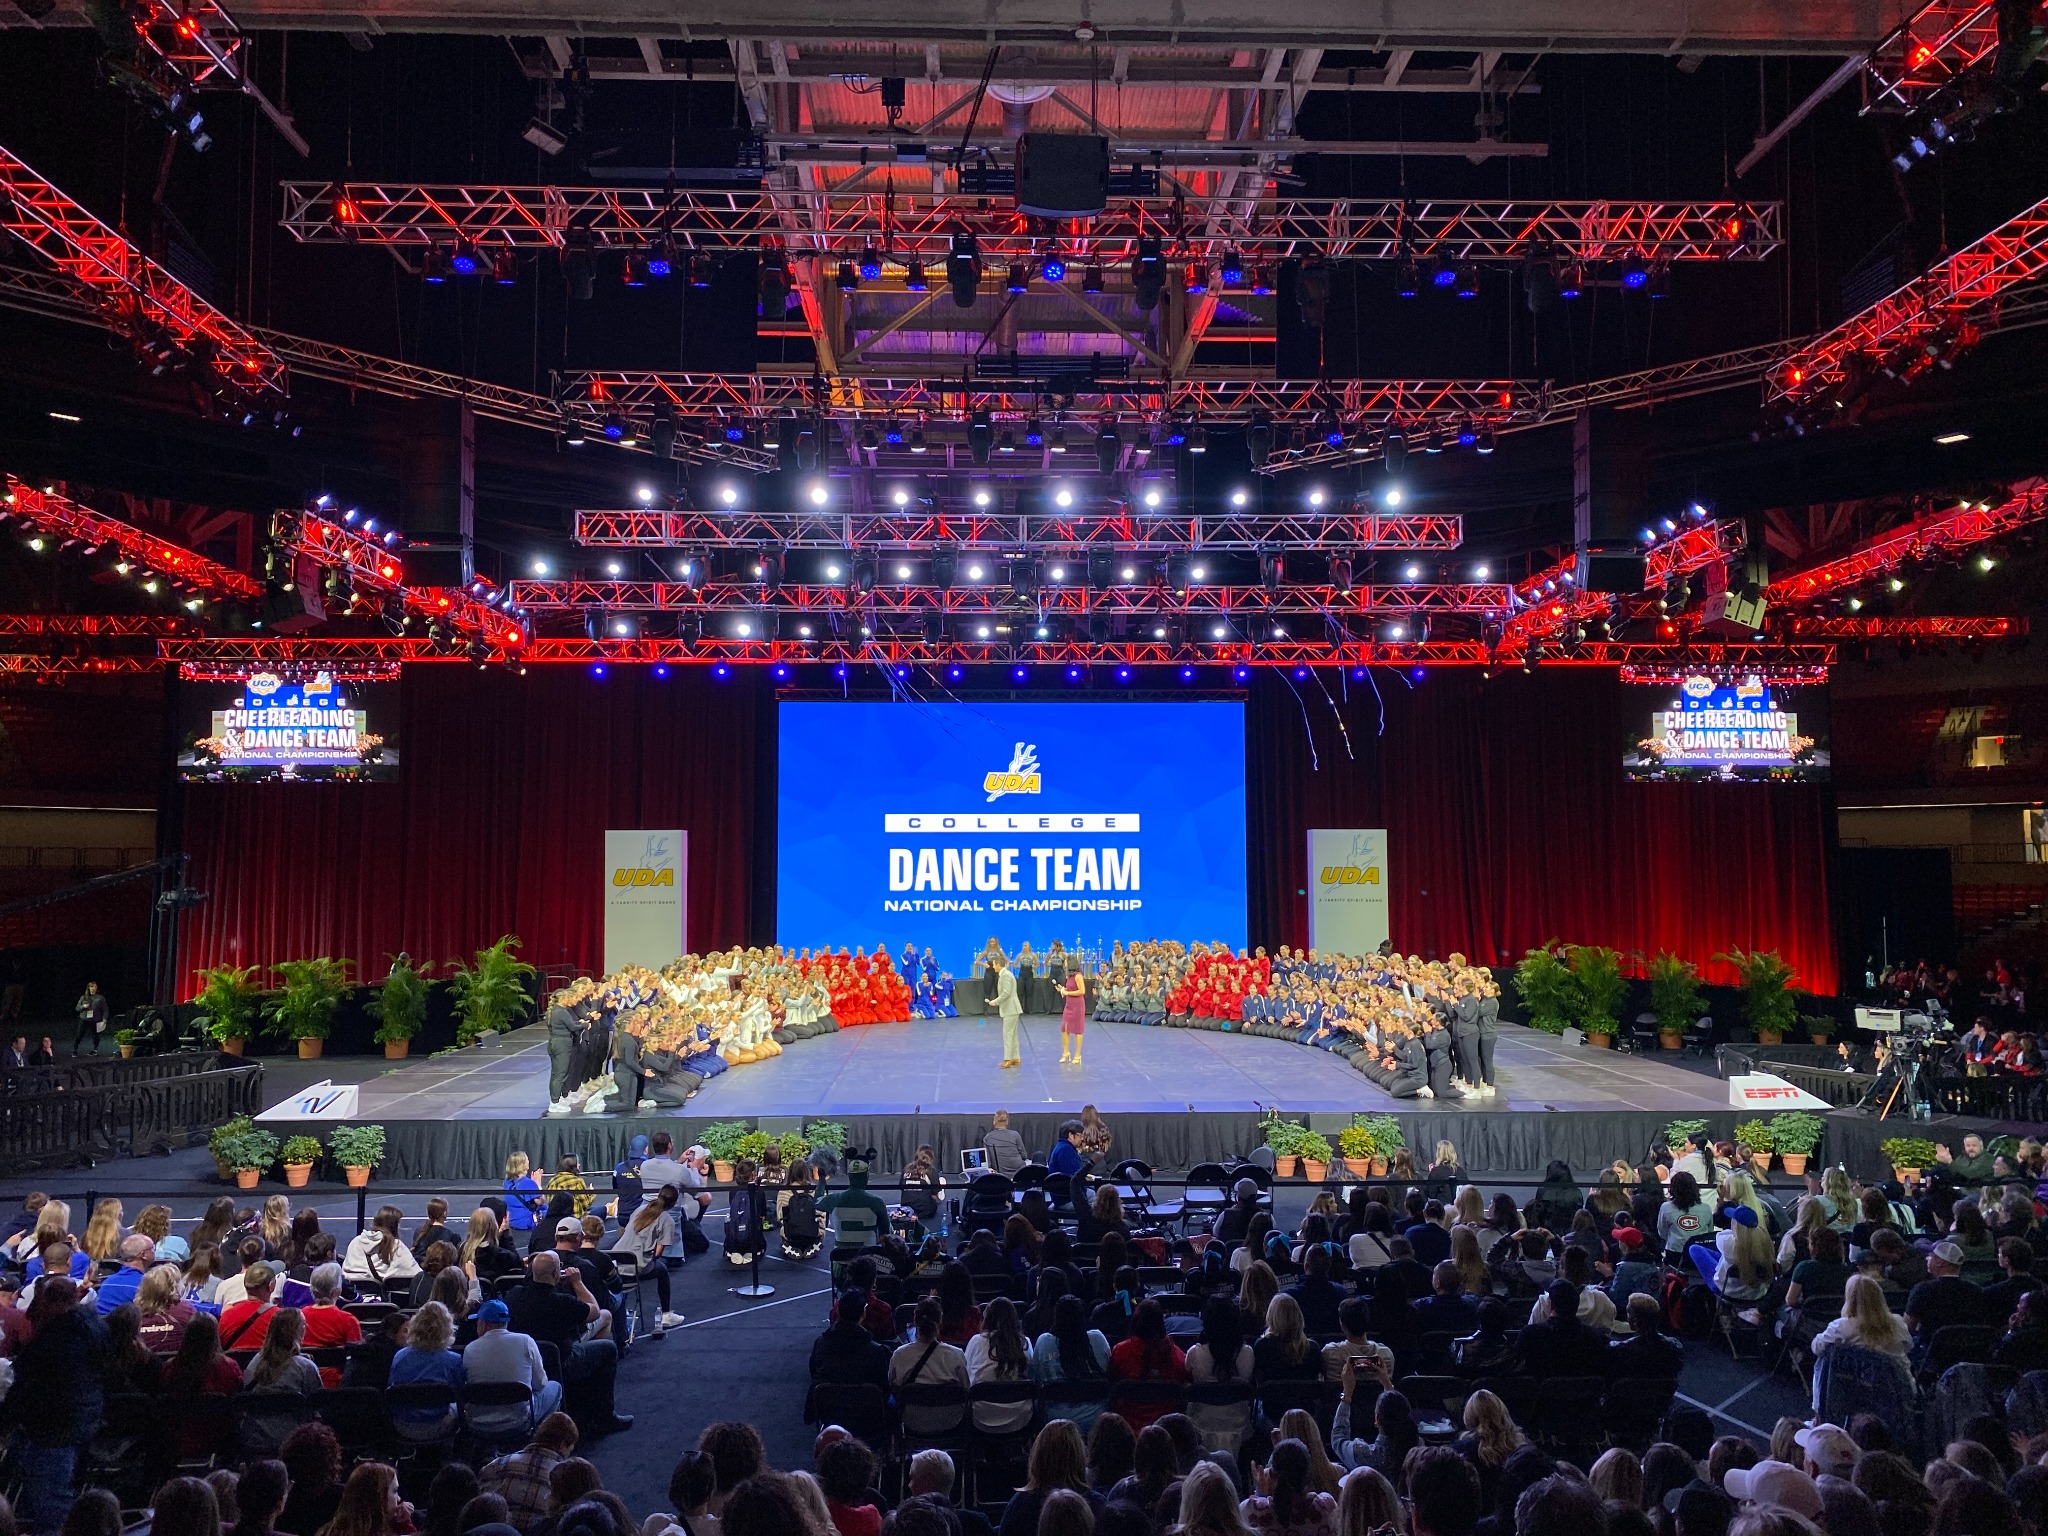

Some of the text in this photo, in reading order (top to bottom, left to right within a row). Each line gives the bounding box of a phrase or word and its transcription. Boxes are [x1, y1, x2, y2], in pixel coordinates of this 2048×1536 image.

[304, 683, 331, 691] UDA
[224, 709, 355, 727] CHEERLEADING
[1664, 711, 1787, 729] CHEERLEADING
[223, 729, 357, 748] & DANCE TEAM
[1664, 730, 1790, 749] & DANCE TEAM
[220, 751, 358, 759] NATIONAL CHAMPIONSHIP
[985, 774, 1040, 792] UDA
[908, 818, 1116, 828] COLLEGE
[612, 868, 674, 887] UDA
[889, 848, 1140, 891] DANCE TEAM
[1320, 866, 1380, 885] UDA
[884, 899, 1142, 912] NATIONAL CHAMPIONSHIP
[1743, 1087, 1800, 1099] ESPN
